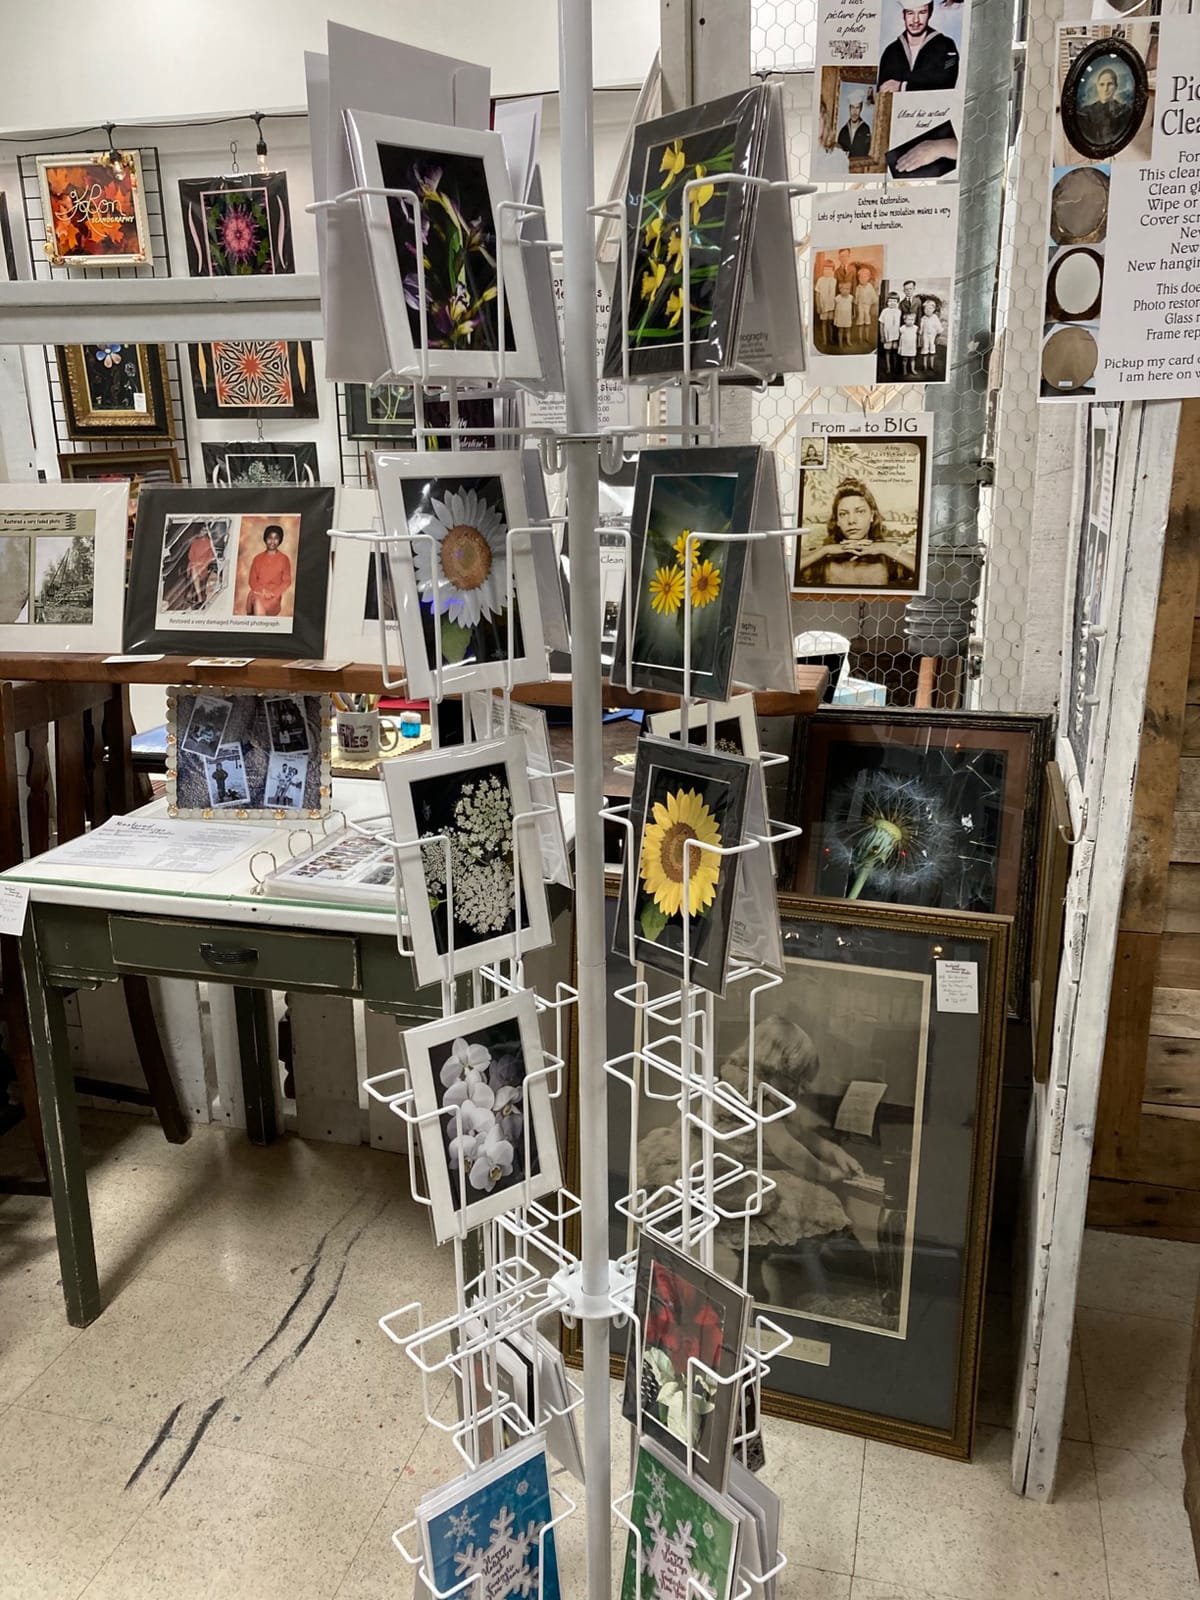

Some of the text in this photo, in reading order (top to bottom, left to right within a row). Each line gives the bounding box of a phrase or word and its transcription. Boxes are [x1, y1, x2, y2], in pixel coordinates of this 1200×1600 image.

[824, 8, 877, 23] picture from
[842, 23, 866, 37] photo
[1178, 151, 1200, 163] For
[1139, 168, 1165, 181] This
[1148, 183, 1186, 195] Clean
[1147, 198, 1198, 212] Wipe or
[818, 212, 828, 221] Lots
[829, 210, 836, 221] of
[837, 211, 852, 223] grainy
[854, 209, 872, 219] texture
[879, 208, 888, 217] low
[890, 208, 915, 217] resolution
[939, 207, 951, 218] very
[1140, 214, 1179, 226] Cover
[1170, 242, 1200, 255] New
[1127, 260, 1156, 273] New
[1156, 283, 1178, 295] This
[1133, 300, 1166, 312] Photo
[1164, 312, 1193, 325] Glass
[1146, 328, 1181, 341] Frame
[1104, 358, 1144, 370] Pickup
[1147, 358, 1165, 368] my
[1168, 354, 1194, 366] card
[1119, 372, 1123, 382] I
[1126, 374, 1144, 382] am
[1147, 371, 1174, 381] here
[1176, 370, 1192, 379] on
[812, 422, 845, 433] From
[865, 422, 880, 433] to
[884, 417, 918, 433] BIG
[601, 555, 623, 564] Clean
